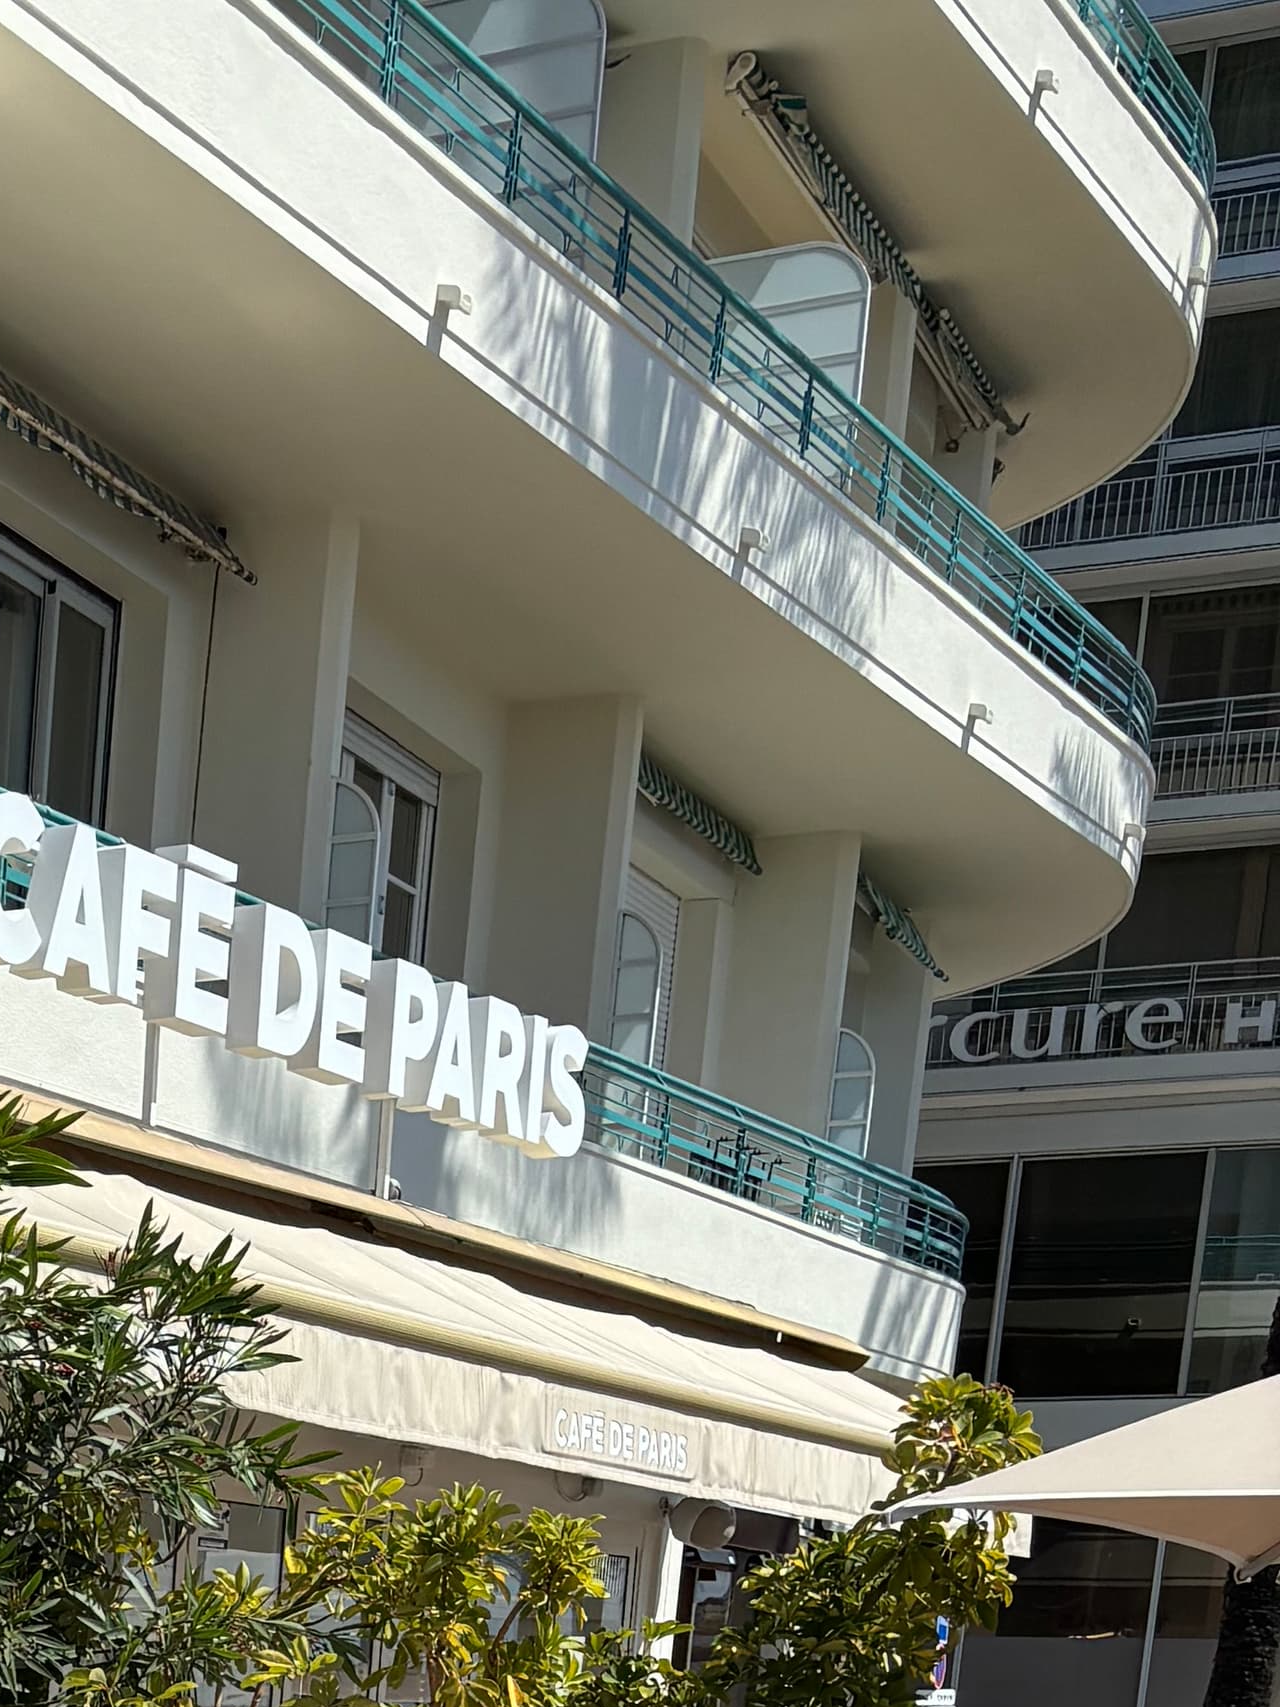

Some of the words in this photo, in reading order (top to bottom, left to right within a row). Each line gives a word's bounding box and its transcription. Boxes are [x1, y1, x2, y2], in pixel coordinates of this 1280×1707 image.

[228, 903, 373, 1085] DE
[365, 958, 589, 1158] PARIS
[608, 1420, 635, 1460] DE
[638, 1425, 689, 1473] PARIS
